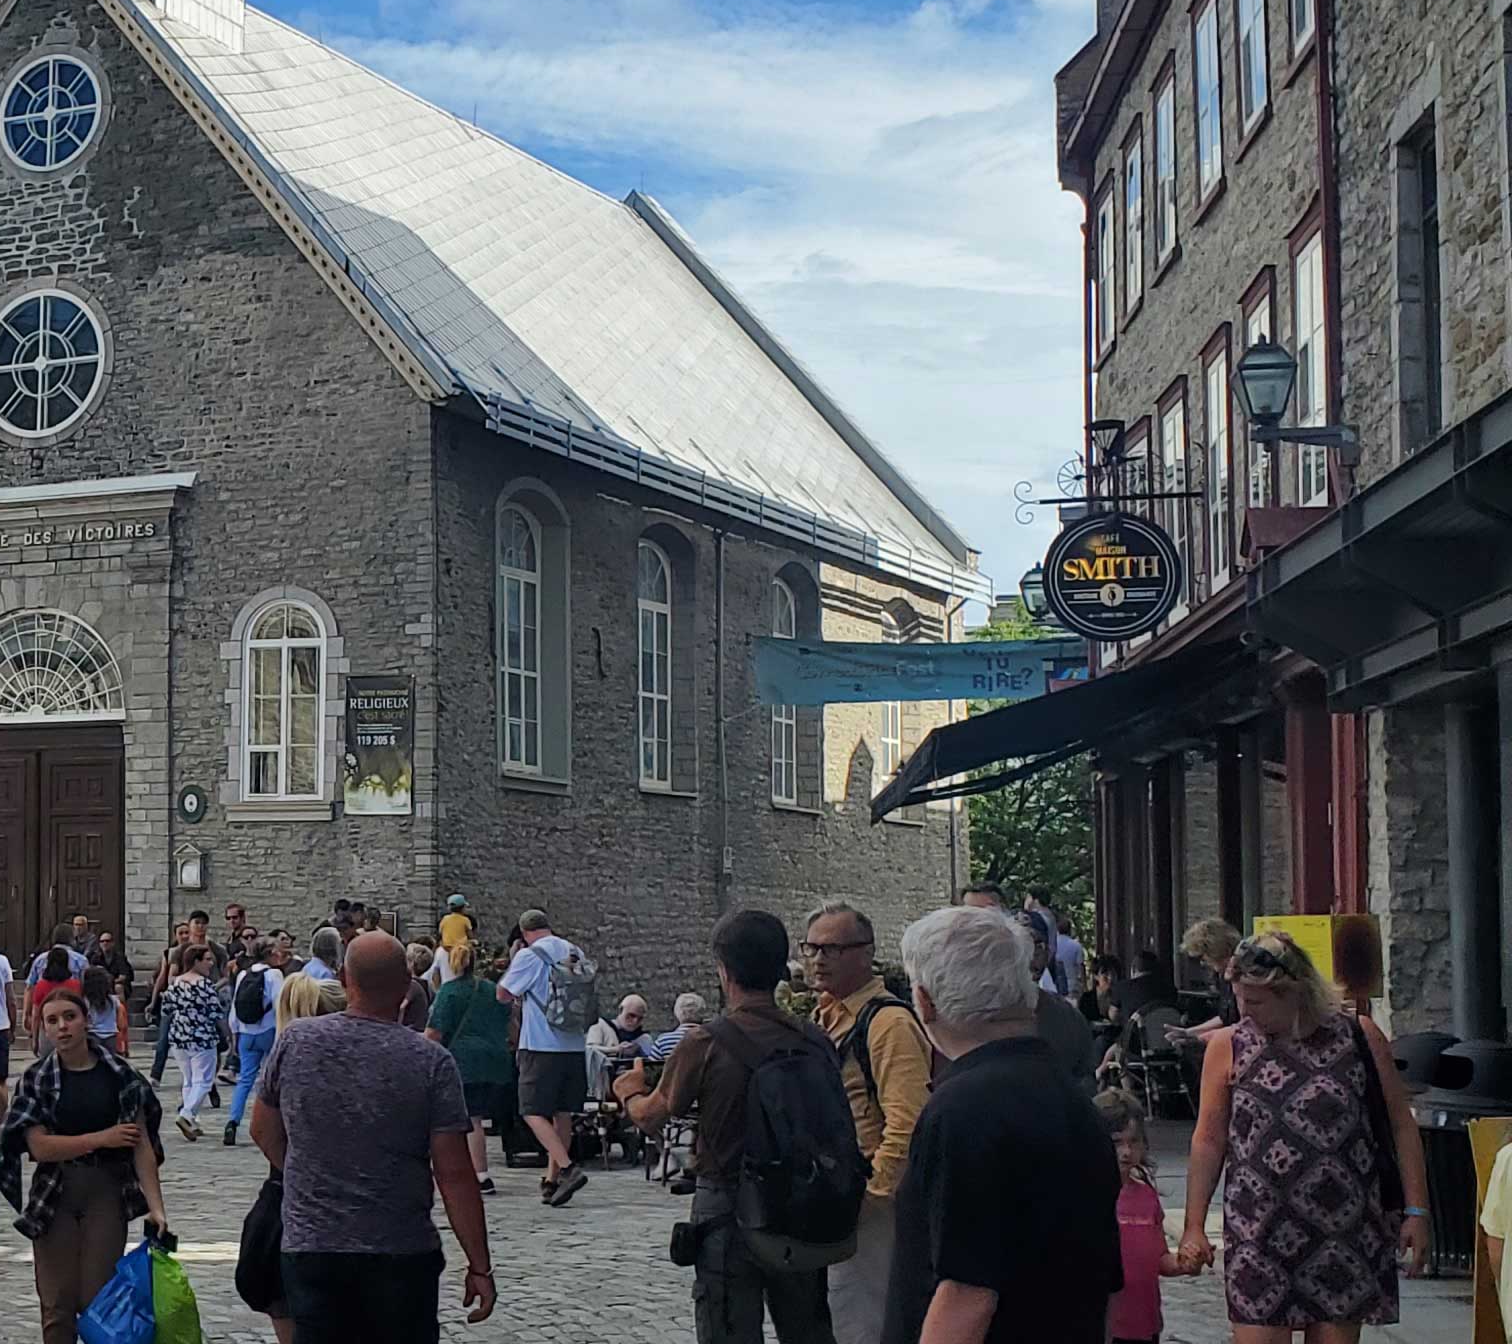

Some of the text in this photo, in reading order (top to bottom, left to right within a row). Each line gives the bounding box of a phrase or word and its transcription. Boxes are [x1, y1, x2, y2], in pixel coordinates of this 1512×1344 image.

[23, 531, 52, 546] DES
[67, 523, 155, 543] VICTOIRES
[1063, 555, 1161, 582] SMITH
[350, 697, 409, 709] RELIGIEUX
[357, 735, 372, 746] 119
[389, 735, 396, 745] $
